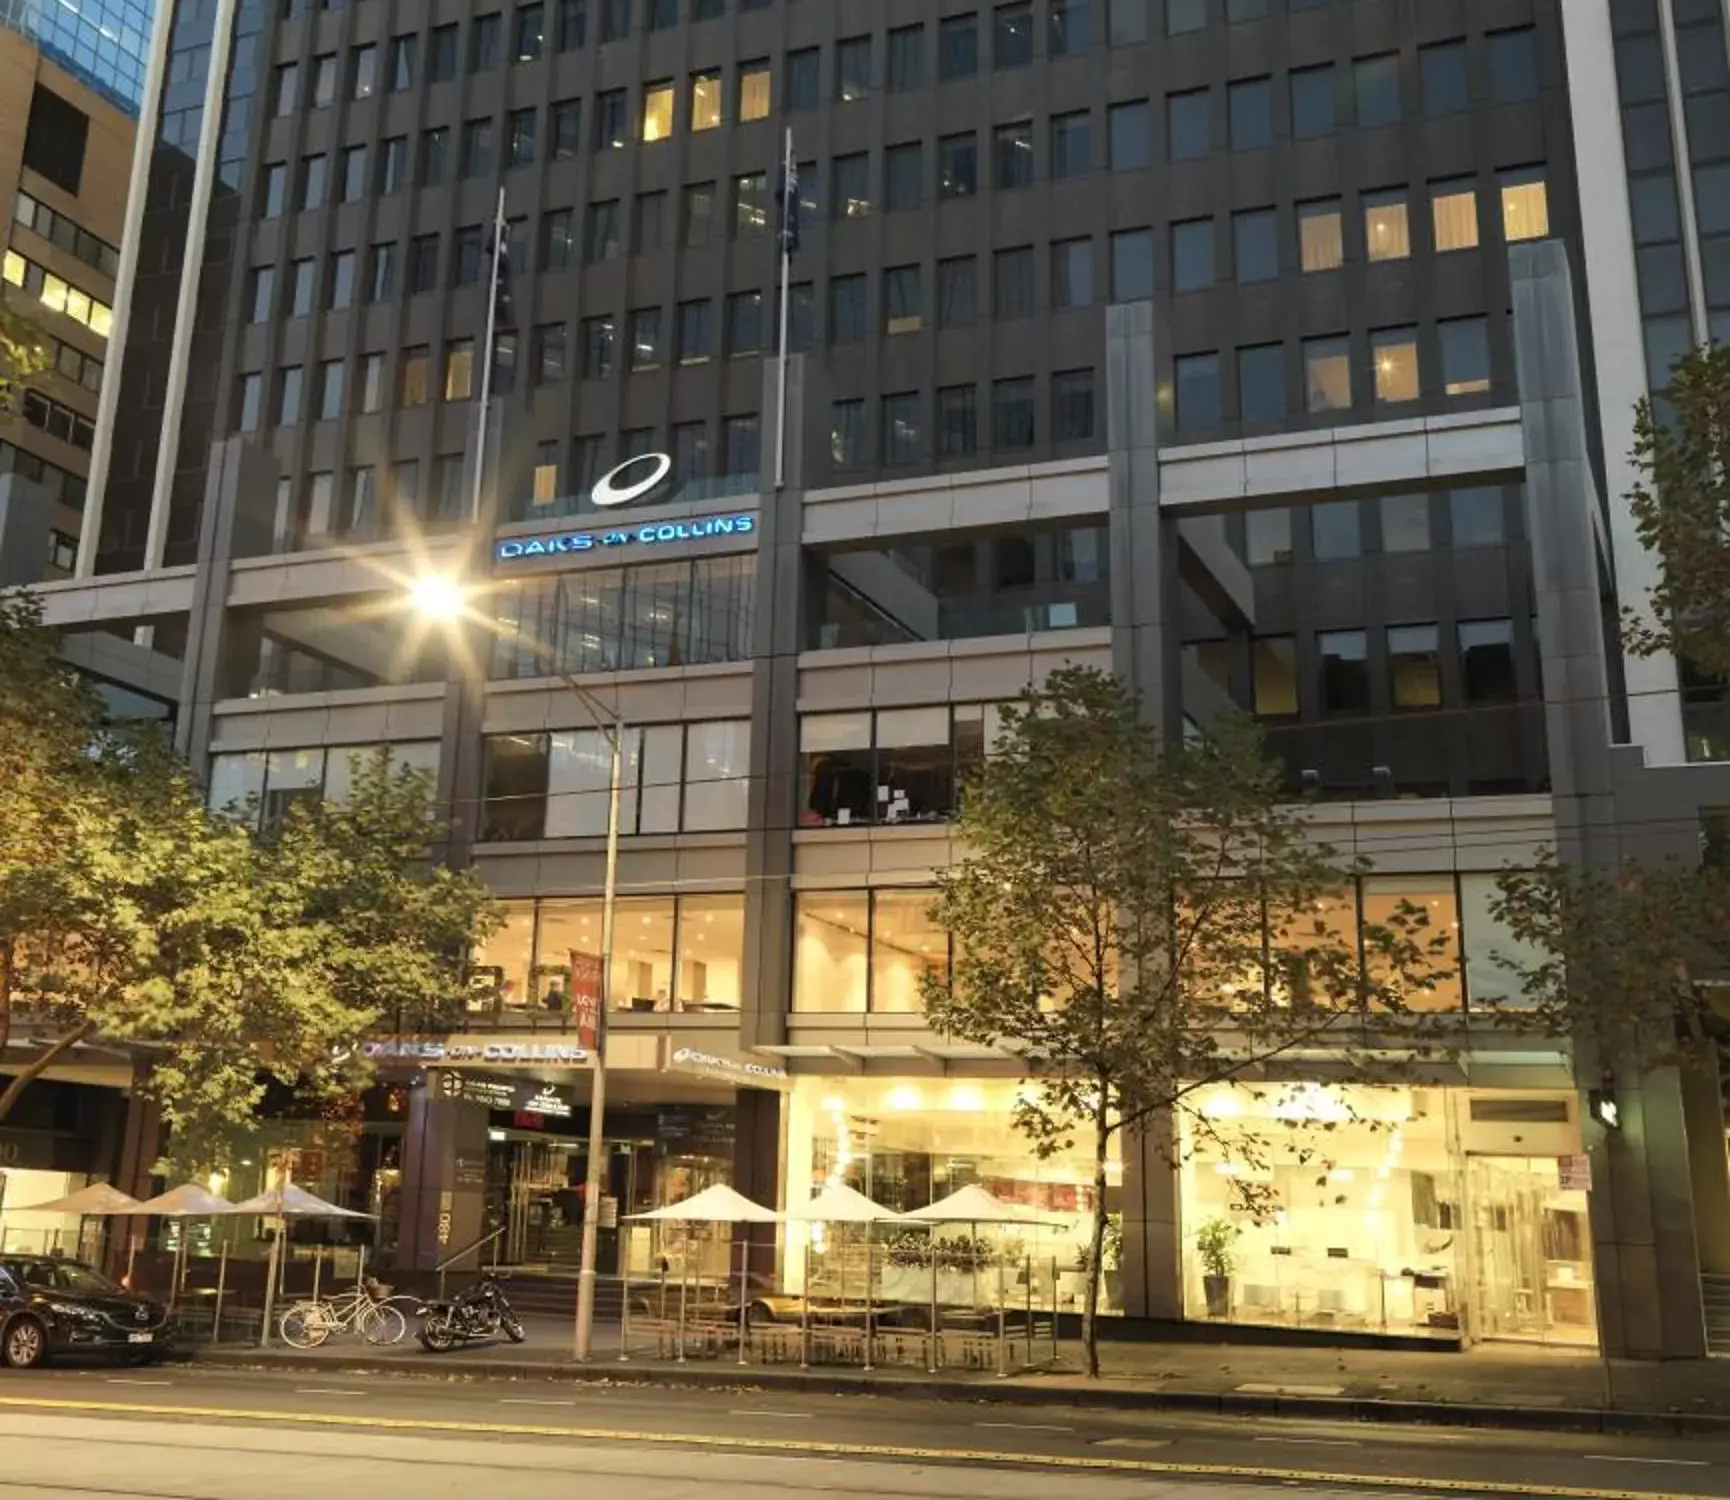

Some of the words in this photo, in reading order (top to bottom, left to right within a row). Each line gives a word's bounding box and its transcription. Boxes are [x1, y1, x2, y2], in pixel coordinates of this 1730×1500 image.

[500, 534, 594, 558] OAKS
[639, 516, 753, 543] COLLINS
[484, 1043, 588, 1061] COLLINS
